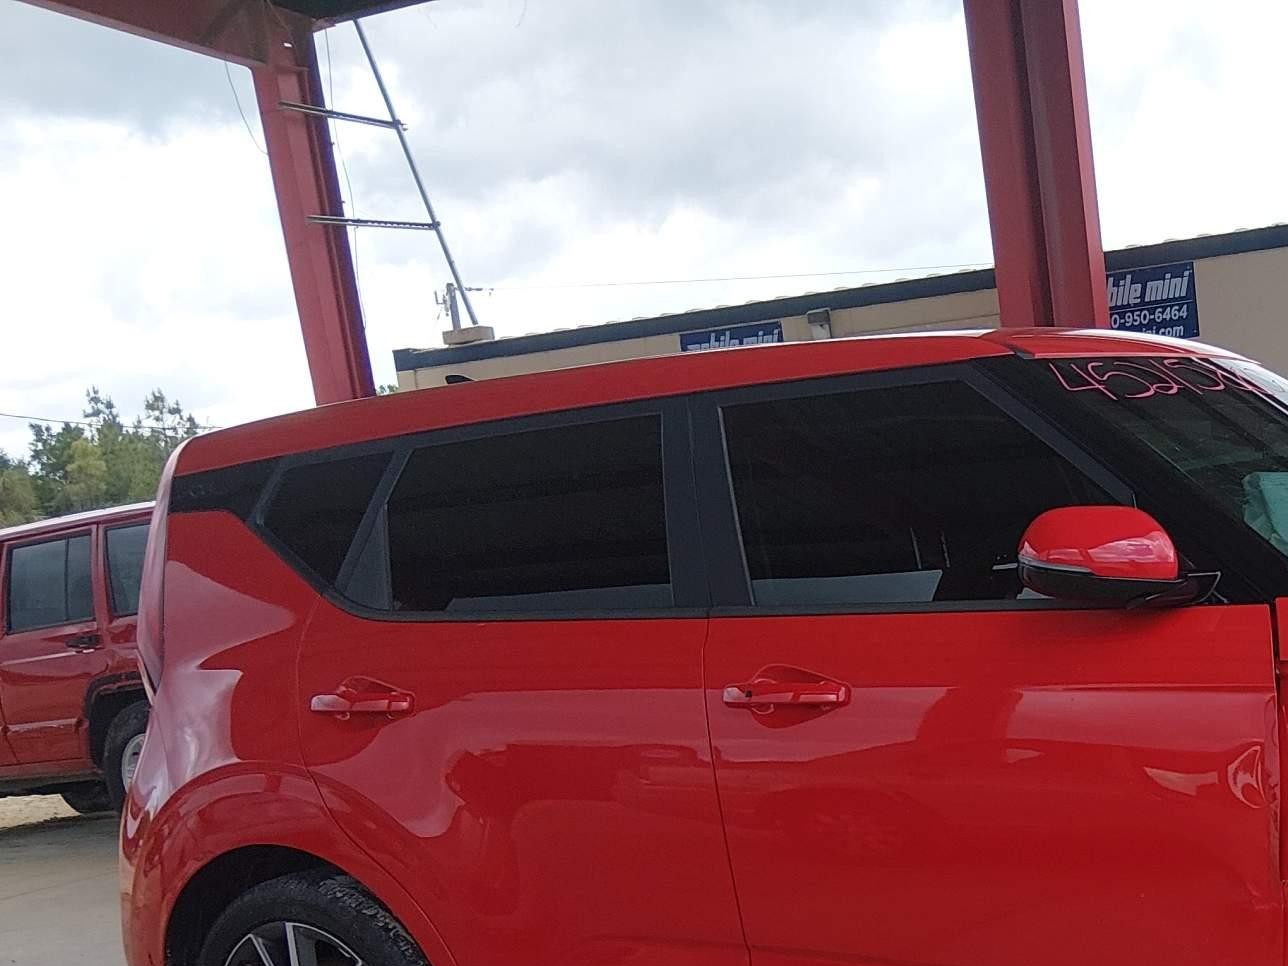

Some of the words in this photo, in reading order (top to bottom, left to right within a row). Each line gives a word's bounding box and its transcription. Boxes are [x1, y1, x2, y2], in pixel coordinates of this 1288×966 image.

[1108, 274, 1142, 306] bile
[1144, 270, 1190, 303] mini
[1111, 304, 1188, 329] 0-950-6464
